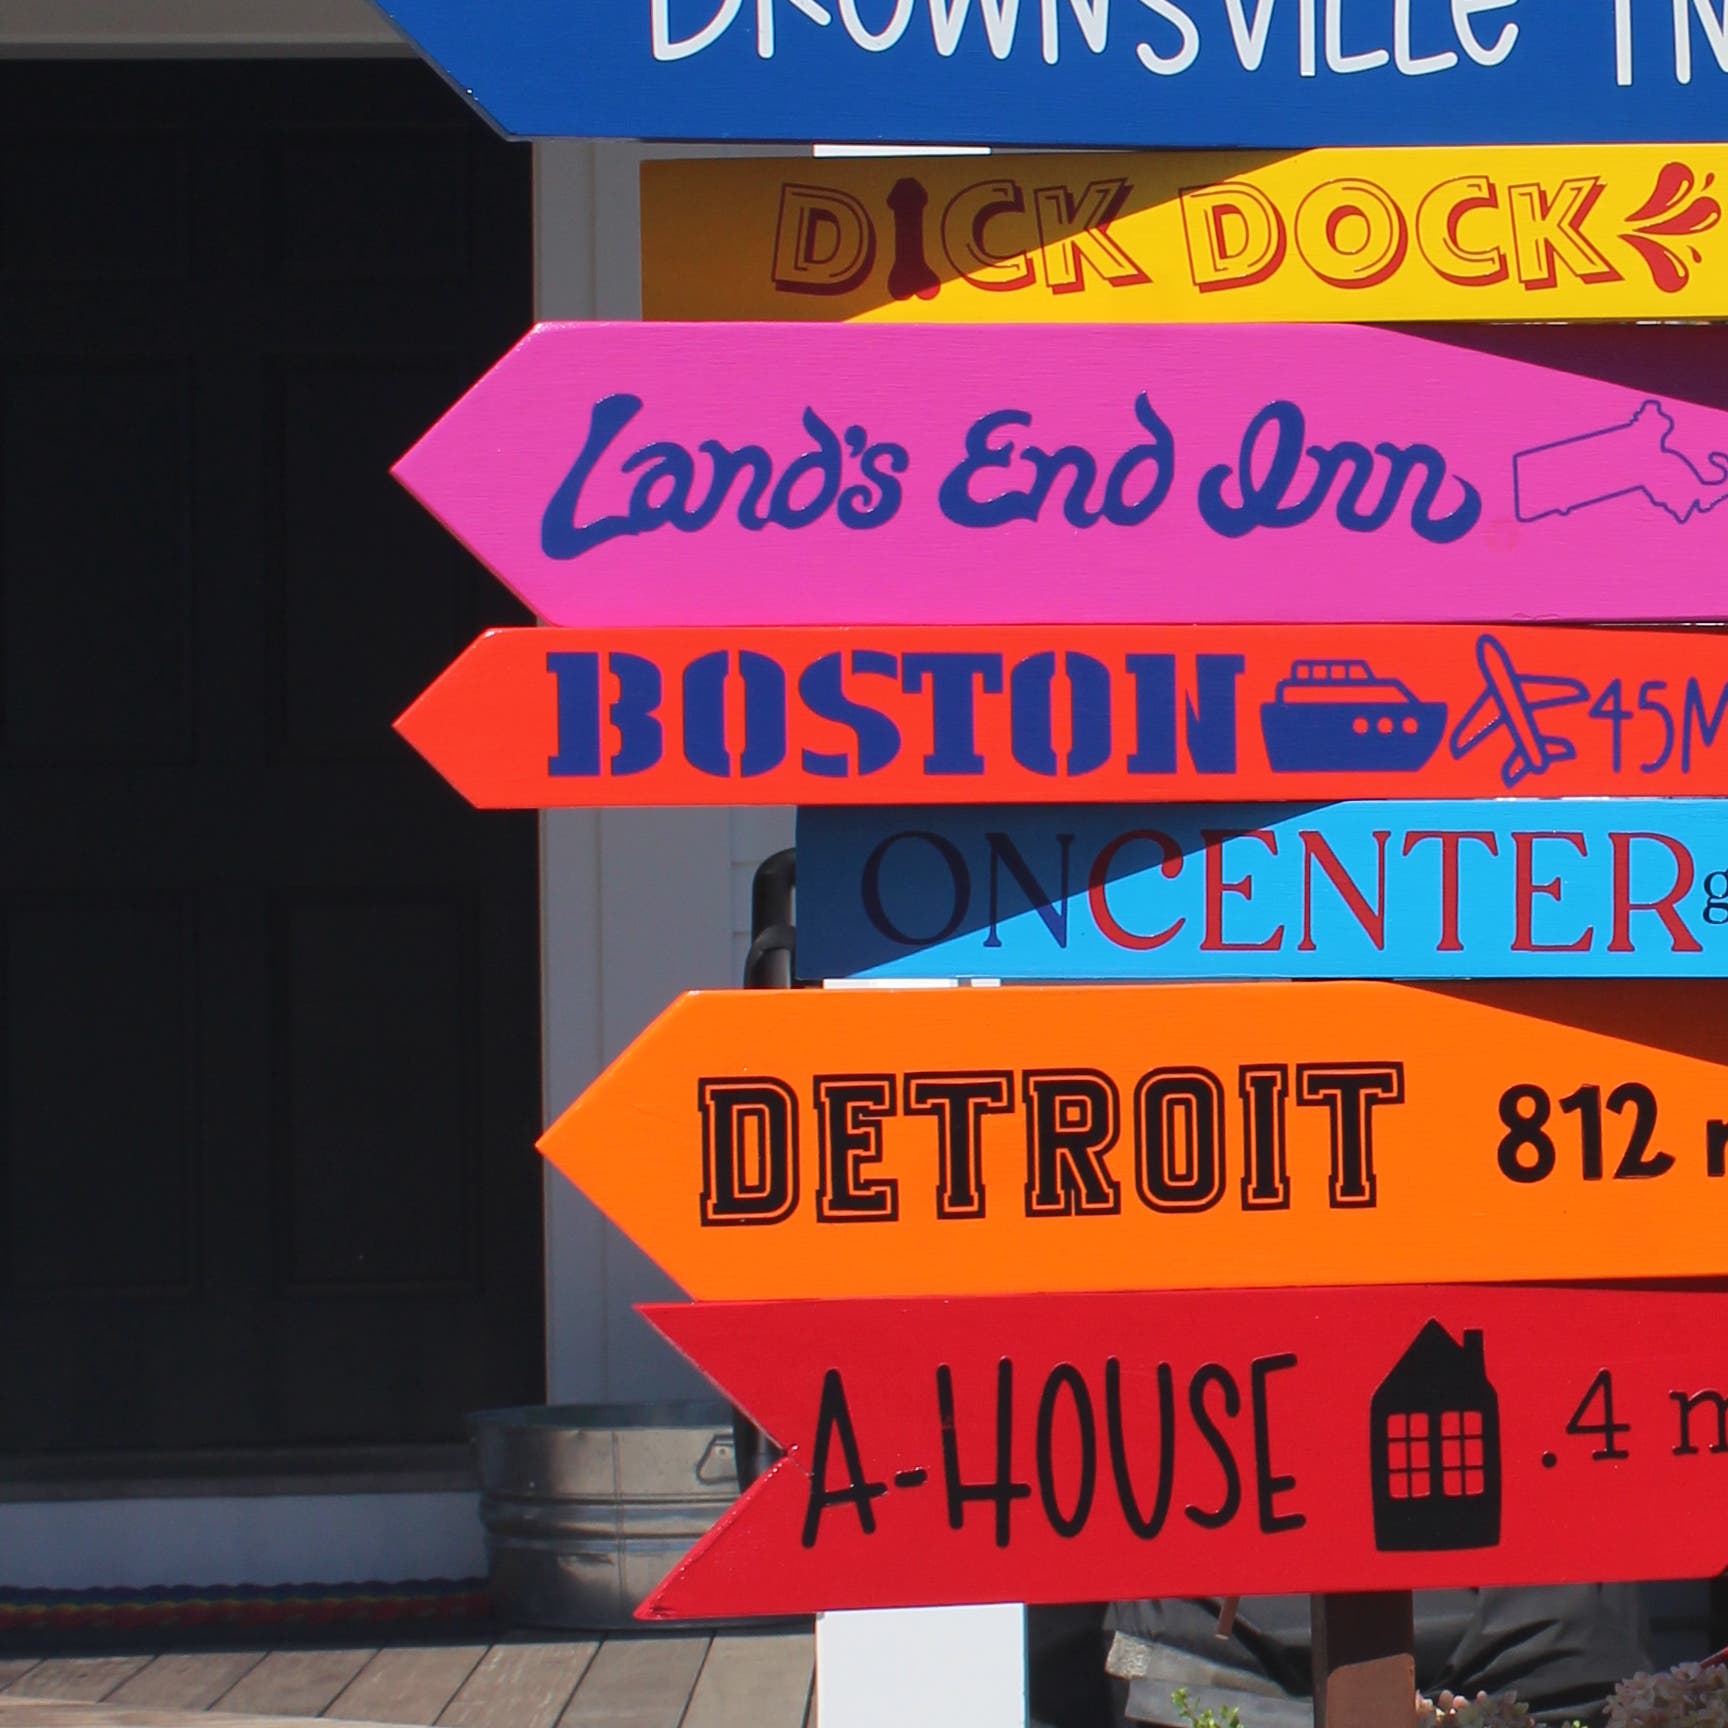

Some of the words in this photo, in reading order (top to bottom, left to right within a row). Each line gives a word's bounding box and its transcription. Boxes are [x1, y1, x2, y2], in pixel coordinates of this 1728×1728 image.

[1179, 175, 1624, 293] DOCK
[541, 392, 911, 561] Land's
[937, 390, 1176, 529] End
[1198, 399, 1482, 544] Inn
[545, 648, 1246, 779] BOSTON
[860, 828, 1704, 954] ONCENTER
[697, 1060, 1405, 1227] DETROIT
[1495, 1083, 1675, 1184] 812
[801, 1352, 1307, 1549] A-HOUSE
[1539, 1367, 1632, 1471] .4
